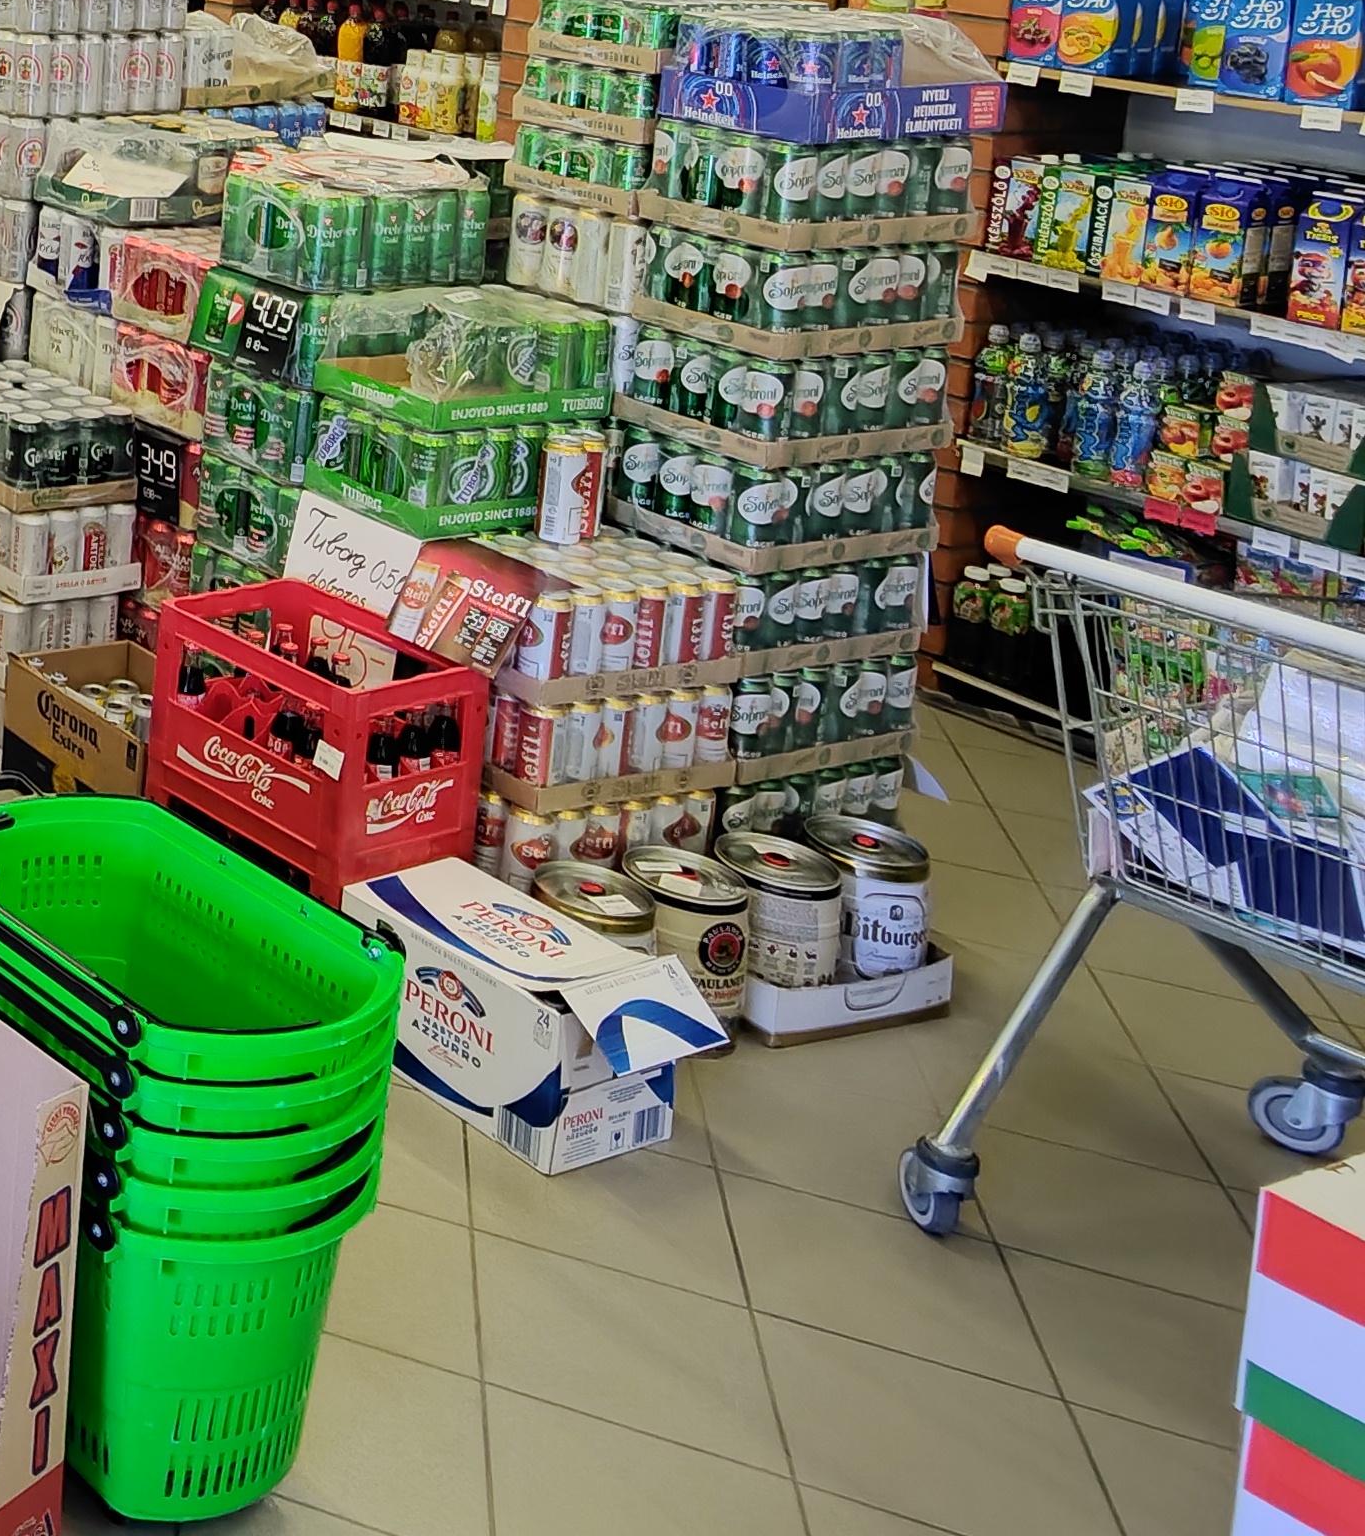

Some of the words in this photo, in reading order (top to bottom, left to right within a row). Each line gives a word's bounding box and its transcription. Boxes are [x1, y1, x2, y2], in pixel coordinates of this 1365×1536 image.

[1252, 12, 1281, 30] Ho
[1313, 2, 1355, 22] Hey
[1319, 18, 1352, 36] Ho
[920, 87, 951, 103] NYERJ
[683, 107, 736, 128] Heineken
[911, 102, 958, 119] HEINEKEN
[836, 126, 883, 140] Heineken
[988, 178, 1010, 245] KÉKSZŐLŐ
[1207, 205, 1239, 220] SIÓ
[450, 403, 496, 421] ENJOYED
[496, 402, 524, 419] SINCE
[560, 395, 605, 414] TUBORG
[141, 442, 178, 481] 349
[340, 482, 384, 513] TUBORG
[438, 509, 482, 527] ENJOYED
[482, 506, 513, 523] SINCE
[303, 506, 367, 579] Tuborg
[469, 579, 533, 621] Steffl
[36, 689, 101, 754] Corona
[51, 722, 86, 761] Extra
[203, 735, 273, 794] Coca-Cola
[250, 788, 275, 810] Coke
[415, 808, 437, 825] Coke
[459, 900, 568, 960] PERONI
[404, 978, 495, 1056] PERONI
[537, 1008, 551, 1030] 24
[411, 1018, 483, 1070] AZZURRO
[422, 1014, 471, 1051] NASTRO
[562, 1107, 605, 1132] PERONI
[31, 1185, 73, 1476] MAXI
